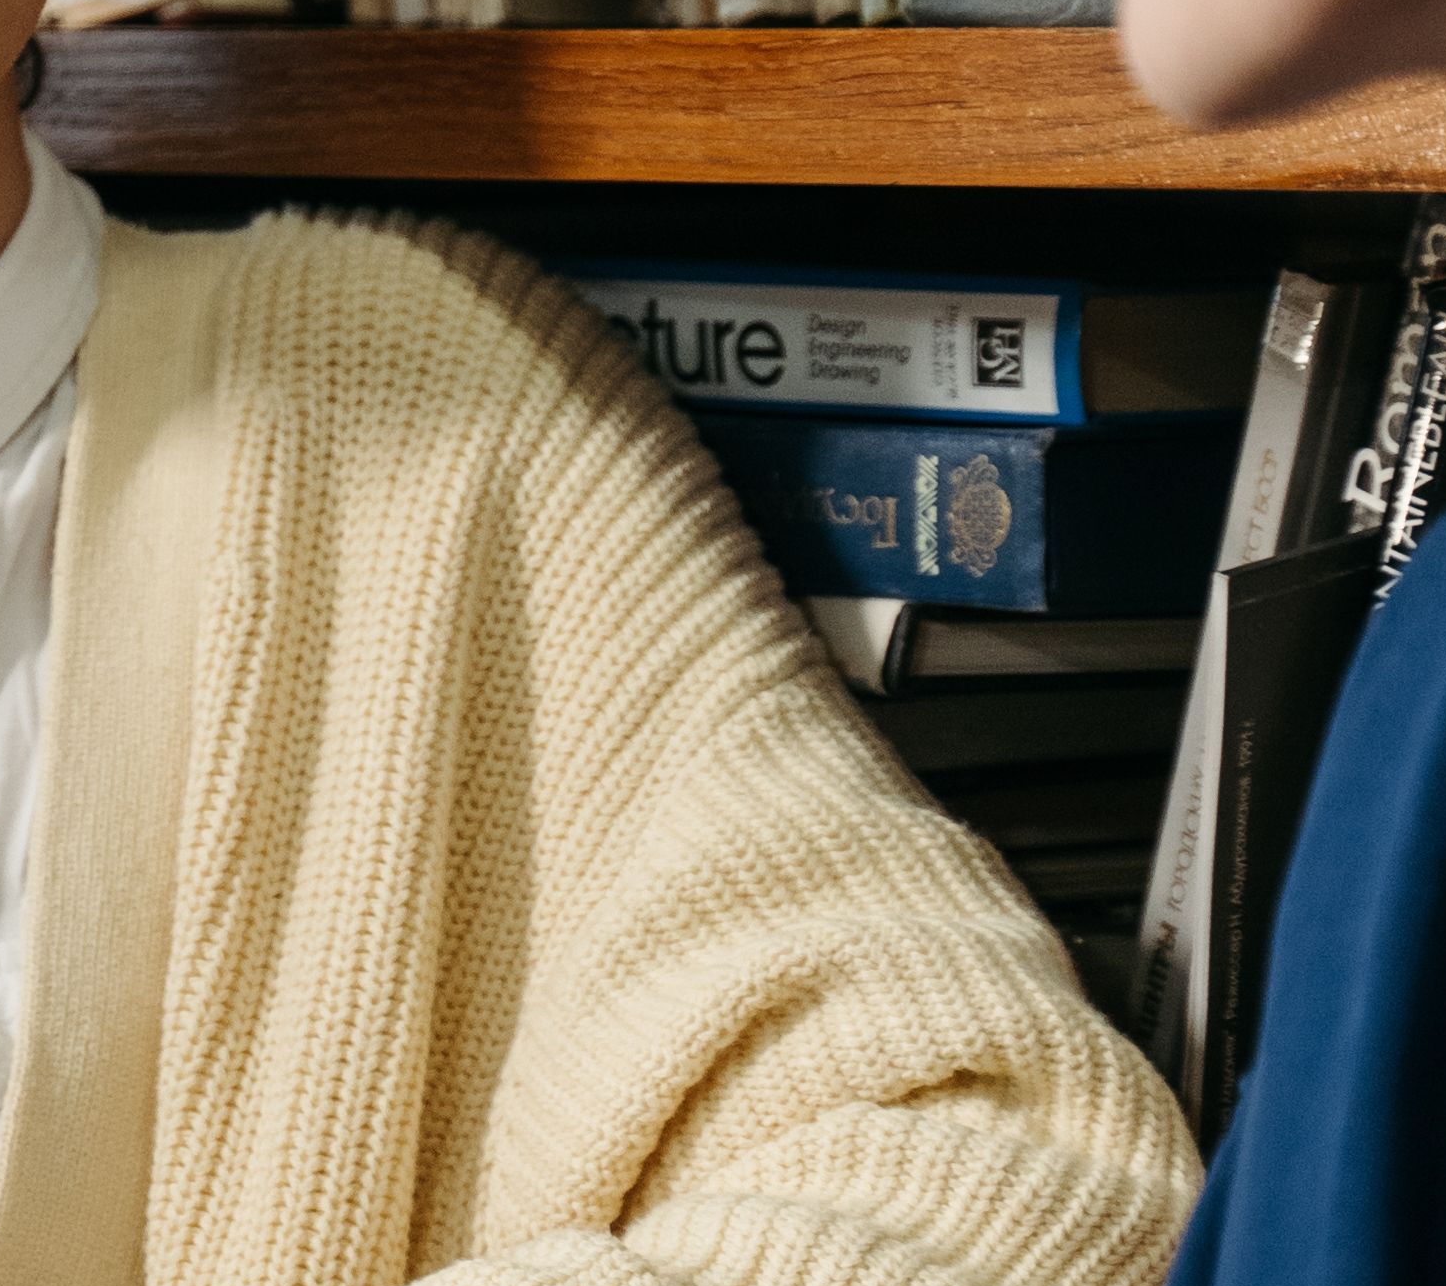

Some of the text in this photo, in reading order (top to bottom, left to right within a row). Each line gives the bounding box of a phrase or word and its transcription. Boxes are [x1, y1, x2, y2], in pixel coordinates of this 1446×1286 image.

[806, 312, 867, 339] Design
[806, 335, 913, 365] Engineering
[806, 358, 882, 386] Drawing
